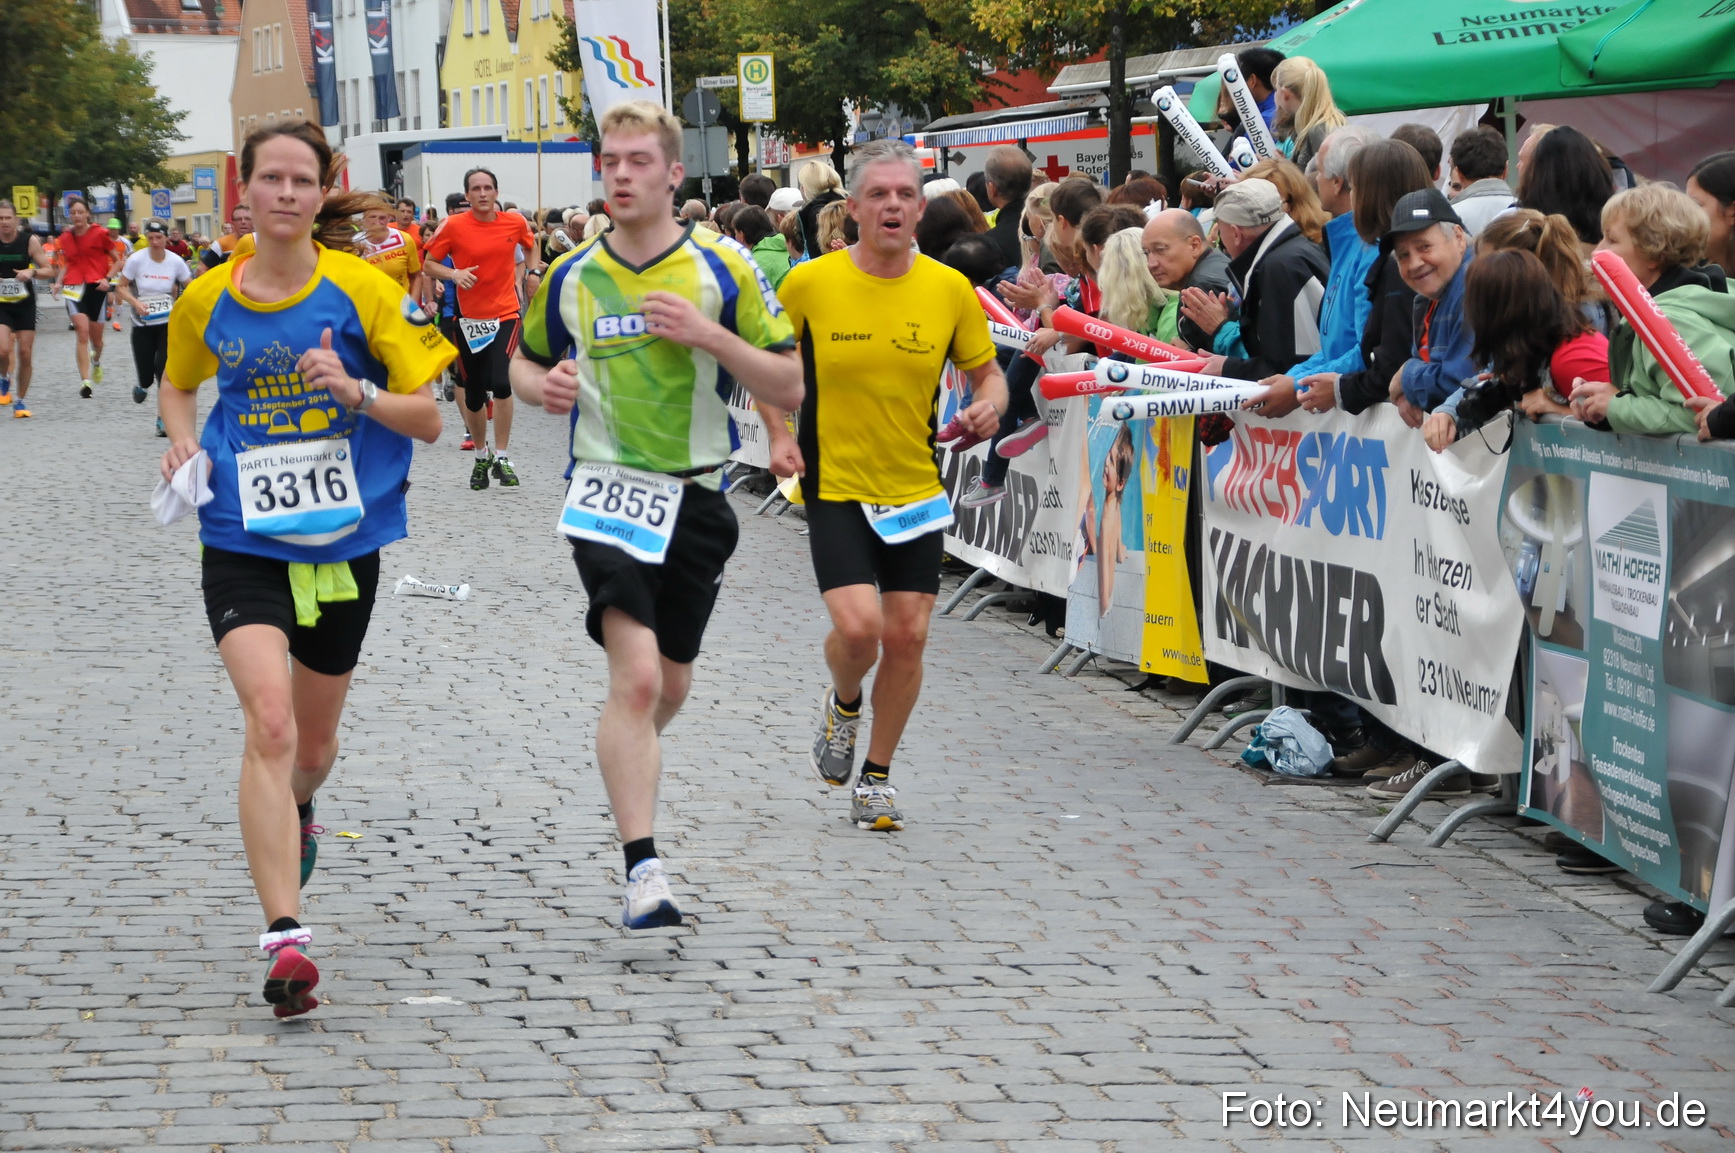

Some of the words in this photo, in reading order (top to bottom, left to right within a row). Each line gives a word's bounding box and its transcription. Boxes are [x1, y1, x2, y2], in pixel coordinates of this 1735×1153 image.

[474, 58, 492, 78] HOTEL
[703, 78, 718, 86] Ulmer
[719, 77, 735, 85] Gasse
[19, 195, 30, 210] D
[153, 208, 170, 217] TAXI
[2, 284, 20, 295] 226
[466, 321, 498, 339] 2493
[831, 332, 873, 342] Dieter
[1121, 335, 1149, 353] BKK
[1145, 343, 1181, 362] Audi
[308, 393, 329, 404] 2014
[1146, 398, 1196, 417] BMW
[240, 454, 278, 472] PARTL
[280, 451, 332, 466] Neumarkt
[581, 463, 613, 476] PARTL
[616, 469, 665, 490] Neumarkt
[1707, 468, 1730, 491] Bayern
[251, 466, 348, 512] 3316
[578, 477, 669, 527] 2855
[898, 509, 931, 529] Dieter
[595, 519, 635, 541] Bernd
[1426, 542, 1473, 591] Herzen
[1623, 555, 1662, 585] HOFFER
[1603, 647, 1620, 670] 92318
[1616, 675, 1633, 699] 09181
[1603, 700, 1656, 733] www.mathi-hoffer.de
[1612, 735, 1645, 766] Trockenbau
[1591, 753, 1662, 799] Fassadenverkleidungen
